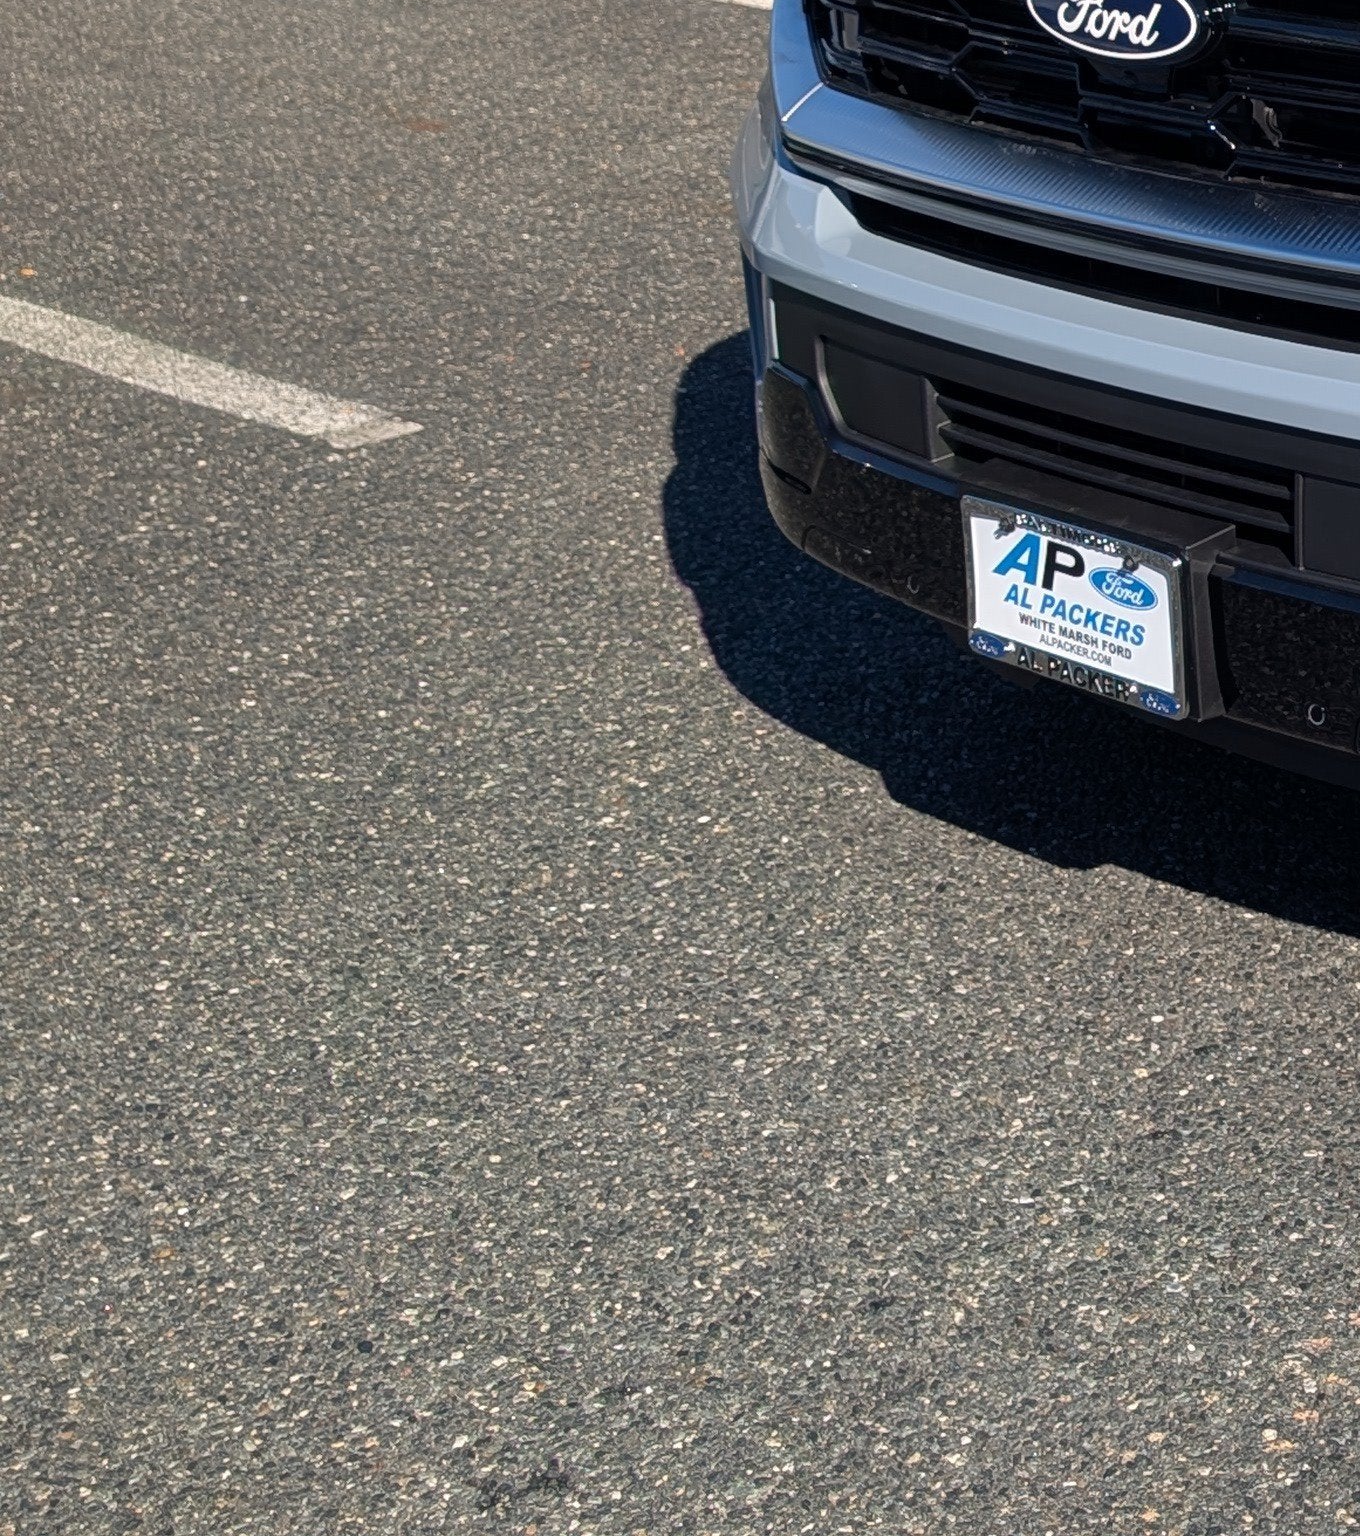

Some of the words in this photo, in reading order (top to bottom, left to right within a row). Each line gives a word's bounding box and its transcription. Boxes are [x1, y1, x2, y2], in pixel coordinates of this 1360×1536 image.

[992, 532, 1086, 592] AP
[1104, 570, 1145, 608] Ford
[1003, 584, 1033, 609] AL
[1040, 595, 1146, 647] PACKERS
[1018, 612, 1056, 635] WHITE
[1058, 622, 1099, 648] MARSH
[1101, 638, 1132, 660] FORD
[1017, 646, 1043, 673] AL
[1047, 656, 1131, 702] PACKER
[1039, 633, 1113, 668] ALPACKER.COM
